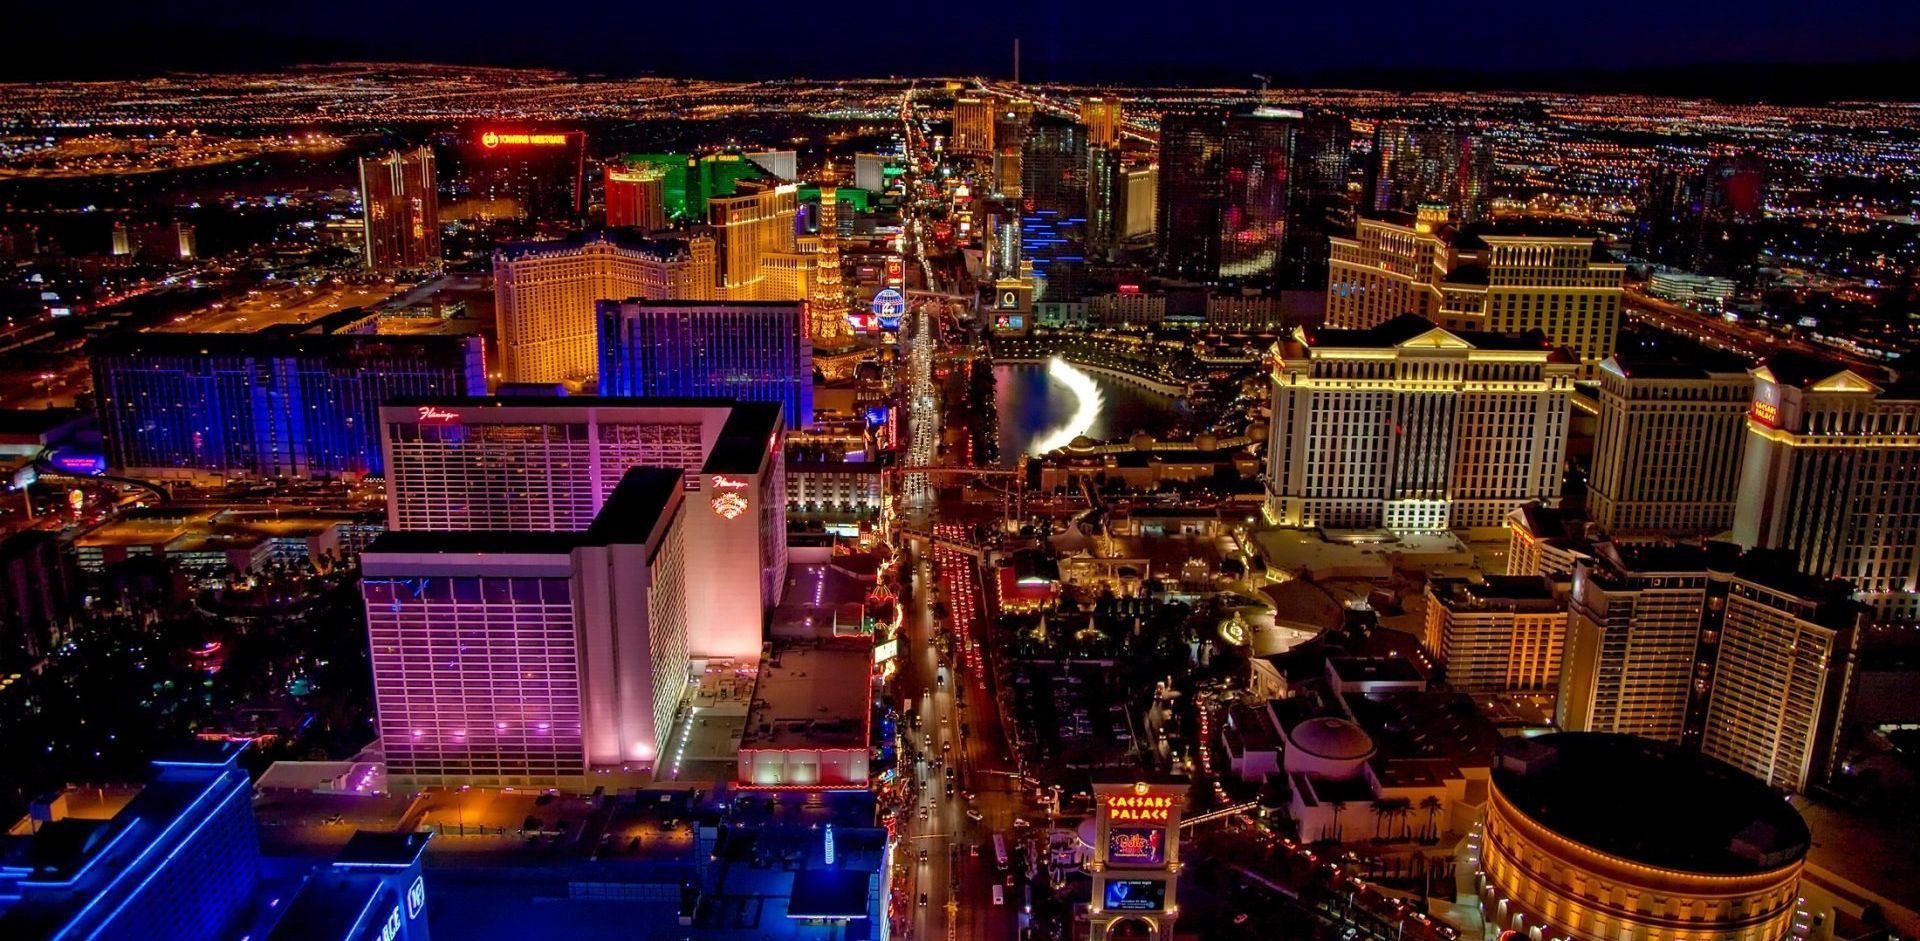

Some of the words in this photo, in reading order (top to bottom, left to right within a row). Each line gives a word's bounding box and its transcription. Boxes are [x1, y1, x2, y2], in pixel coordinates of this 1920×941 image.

[499, 135, 530, 144] TOWERS
[530, 135, 566, 145] WESTGATE
[418, 406, 459, 421] Flamingo
[1755, 401, 1776, 416] CAESARS
[1755, 409, 1775, 422] PALACE
[711, 475, 748, 489] Flamingo
[1108, 797, 1172, 807] CAESARS
[1111, 809, 1168, 819] PALACE
[377, 905, 400, 941] ACE
